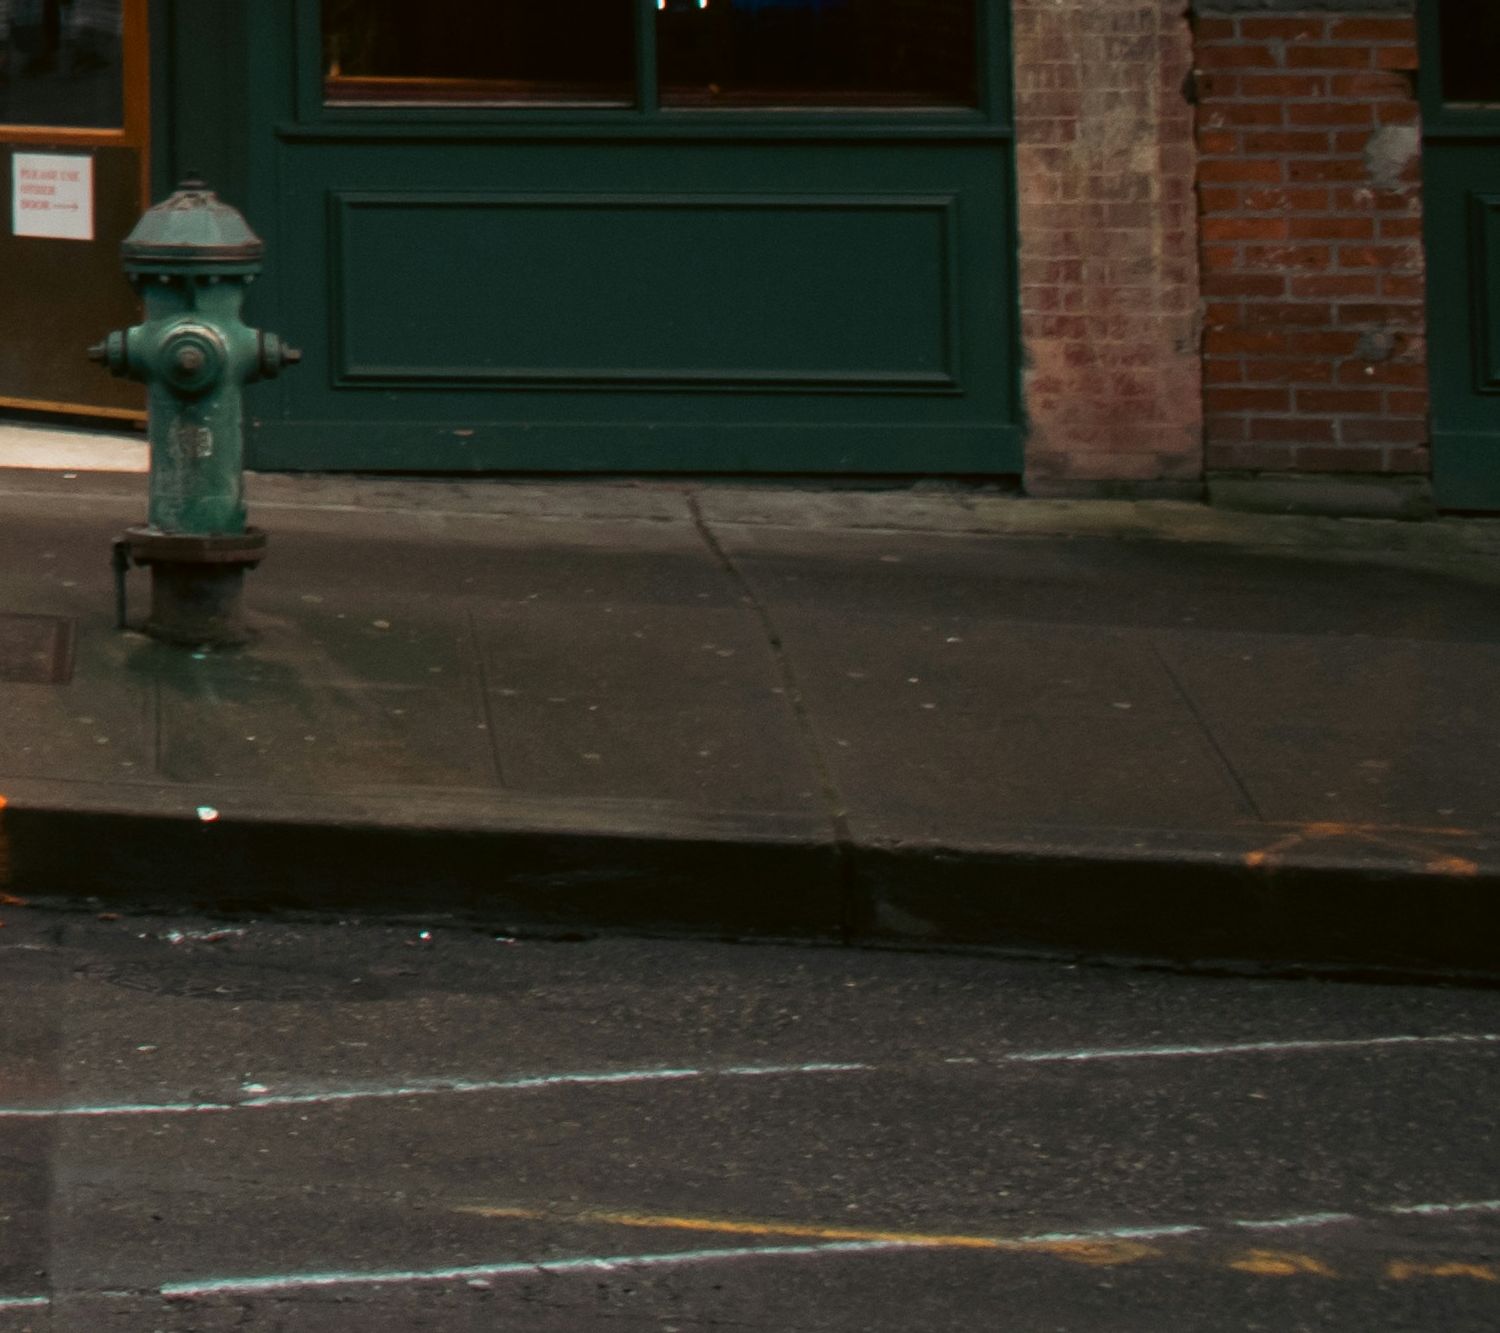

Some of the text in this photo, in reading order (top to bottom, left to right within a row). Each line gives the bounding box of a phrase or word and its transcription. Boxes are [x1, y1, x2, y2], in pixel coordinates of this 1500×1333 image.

[19, 168, 60, 181] PLEASE
[19, 184, 56, 195] OTHER
[19, 199, 51, 211] DOOR
